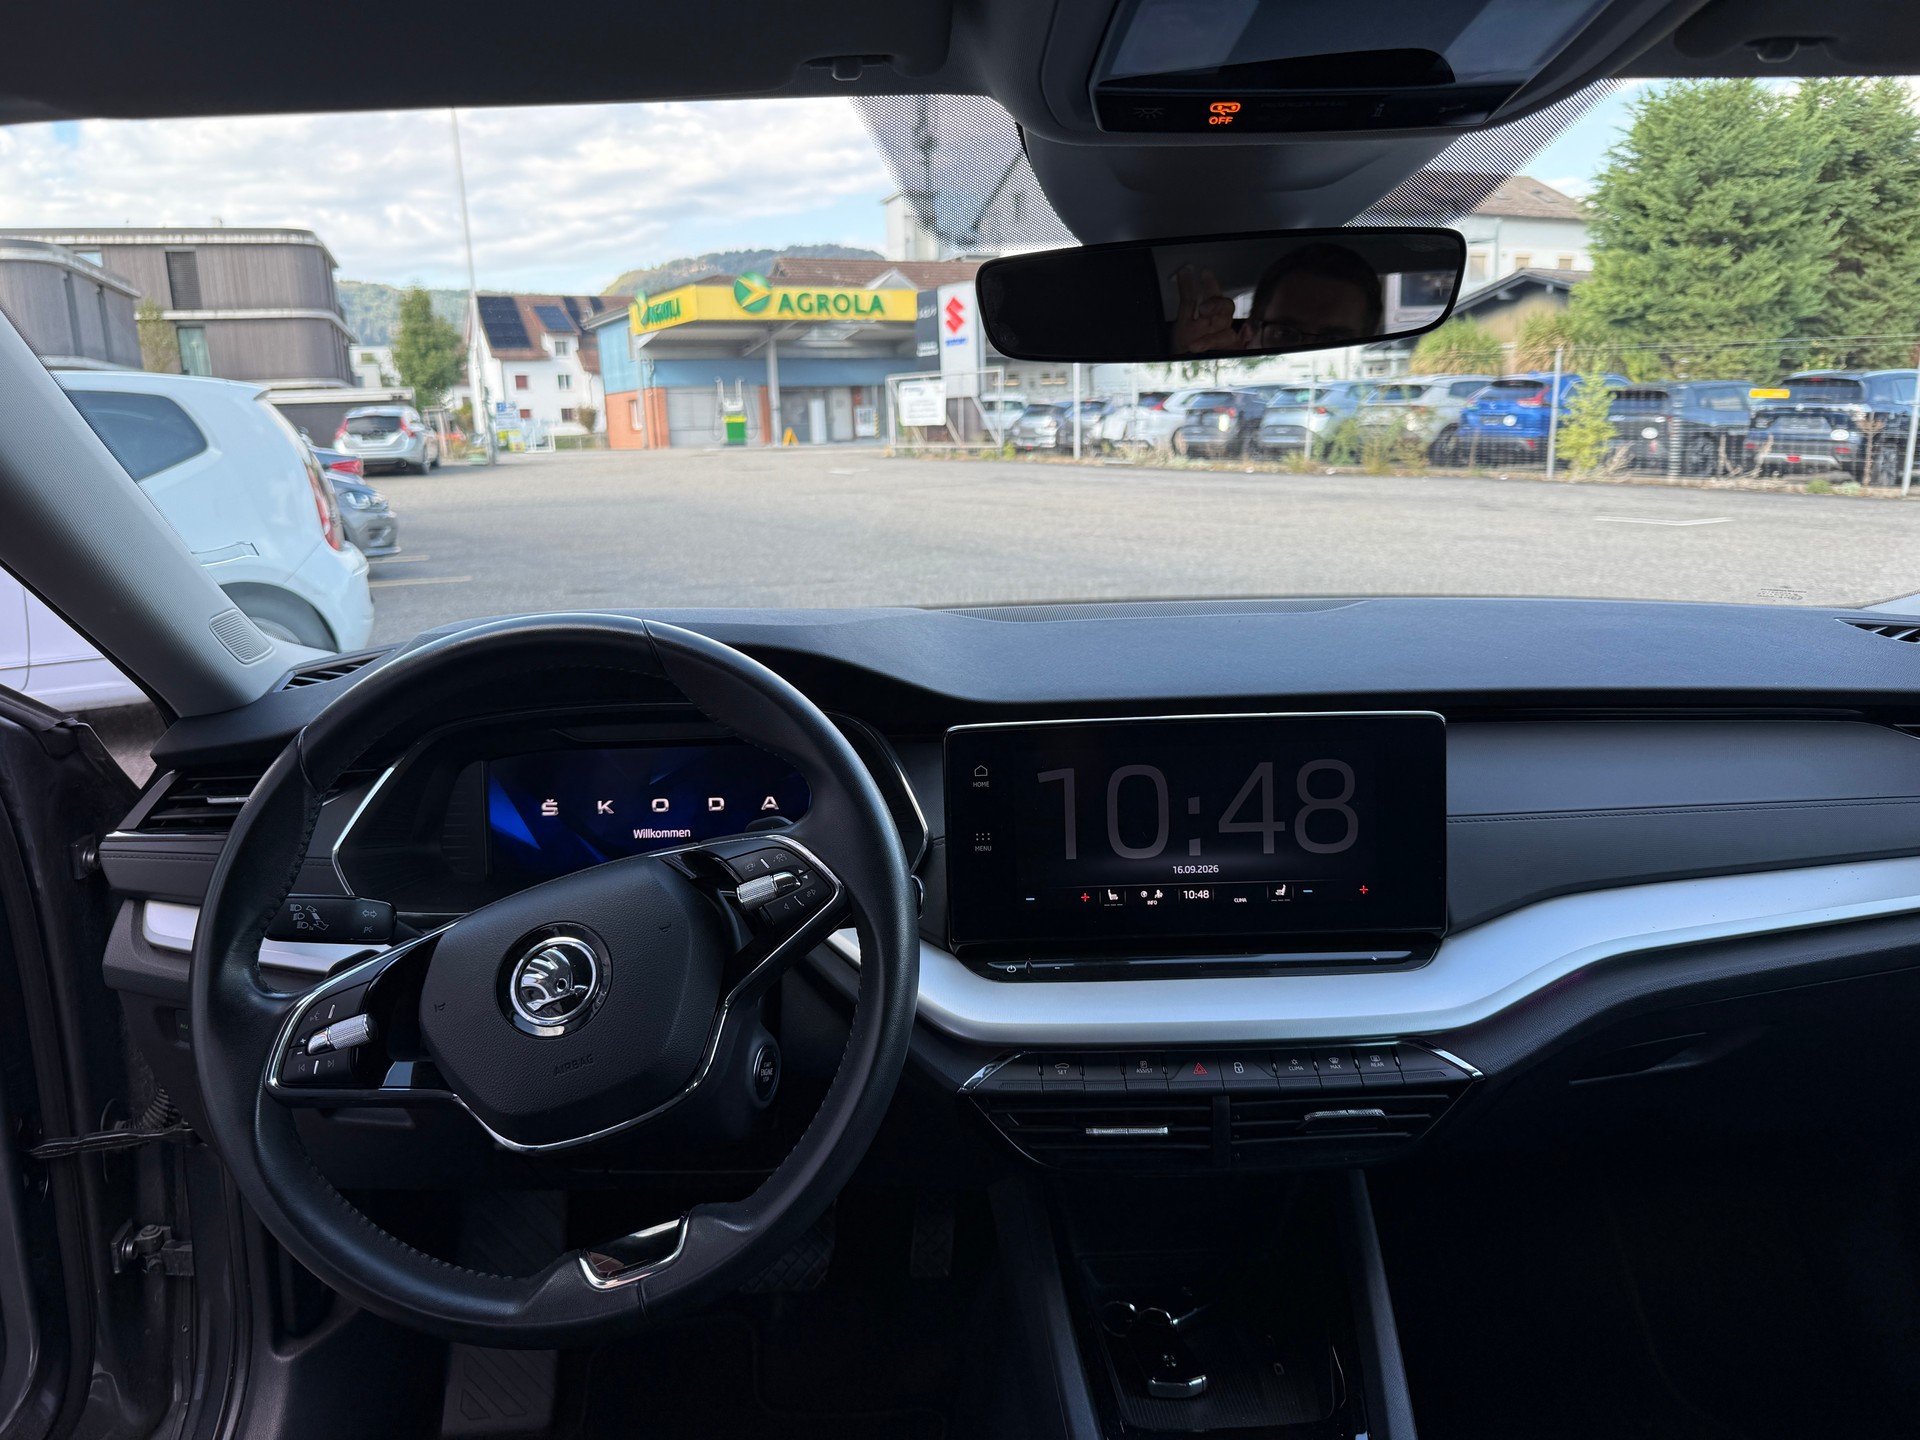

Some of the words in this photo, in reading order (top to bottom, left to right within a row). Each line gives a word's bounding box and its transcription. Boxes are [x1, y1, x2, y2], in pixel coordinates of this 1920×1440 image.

[1208, 116, 1233, 124] OFF
[778, 293, 884, 313] AGROLA
[972, 780, 990, 788] HOME
[1036, 758, 1359, 860] 10:48
[632, 827, 691, 839] Willkommen
[1172, 864, 1220, 874] 16.09.2026
[1183, 889, 1210, 899] 10:48
